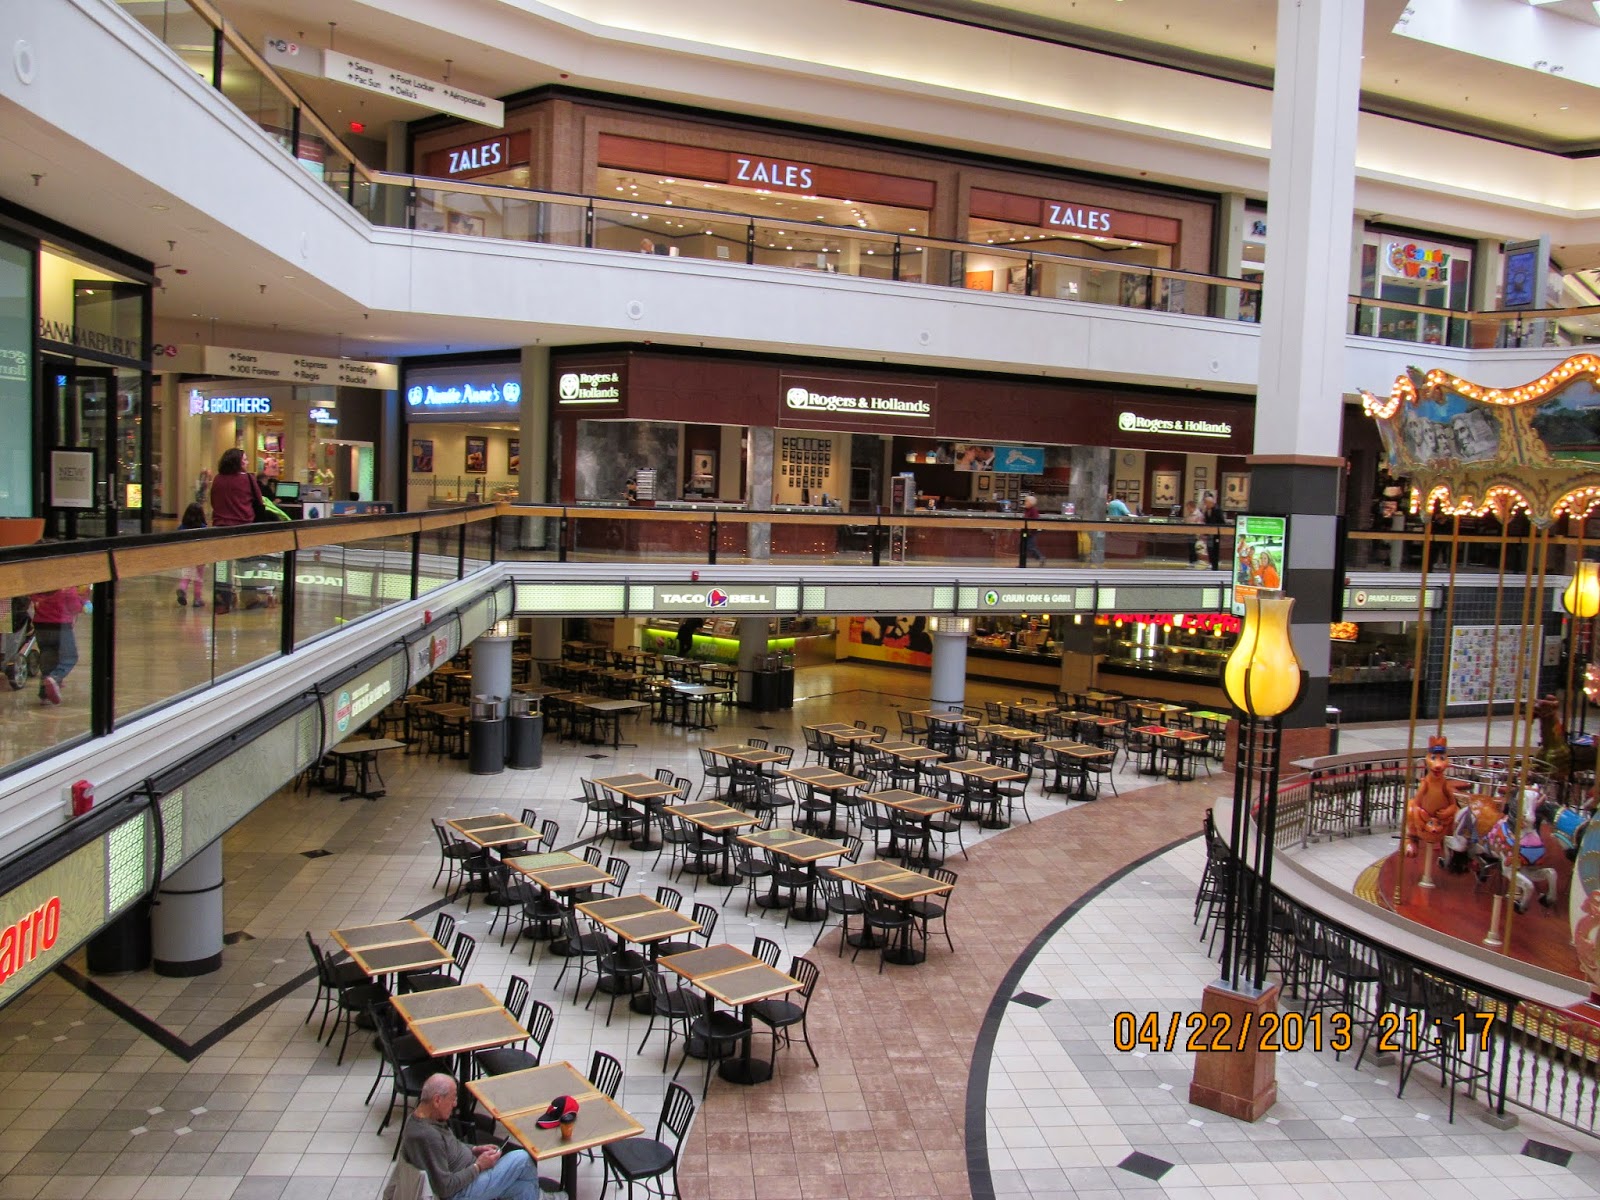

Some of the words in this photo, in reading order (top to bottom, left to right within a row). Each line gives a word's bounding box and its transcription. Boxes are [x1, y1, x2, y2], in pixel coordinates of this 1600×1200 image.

[354, 62, 374, 75] Sears
[354, 74, 367, 85] Pac
[368, 78, 382, 89] Sun
[396, 74, 412, 87] Foot
[413, 80, 435, 93] Locker
[449, 142, 501, 174] ZALES
[736, 158, 814, 190] ZALES
[1049, 204, 1112, 232] ZALES
[1403, 243, 1450, 268] Candy
[1404, 261, 1448, 282] World
[236, 353, 258, 363] Sears
[251, 367, 280, 377] Forever
[300, 359, 328, 372] Express
[300, 370, 320, 382] Regis
[344, 375, 367, 385] Buckle
[579, 373, 610, 387] Rogers
[610, 373, 619, 383] &
[579, 386, 620, 399] Hollands
[211, 396, 271, 413] BROTHERS
[808, 393, 857, 411] Rogers
[857, 397, 869, 409] &
[870, 397, 931, 414] Hollands
[1135, 416, 1174, 432] Rogers
[1174, 420, 1184, 431] &
[1184, 420, 1232, 435] Hollands
[660, 593, 706, 604] TACO
[728, 593, 770, 604] BELL
[1001, 593, 1026, 603] CAJUN
[1043, 593, 1051, 603] &
[1051, 593, 1072, 603] GRILL
[1367, 594, 1390, 603] PANDA
[1389, 594, 1417, 603] EXPRESS
[0, 896, 61, 985] arro
